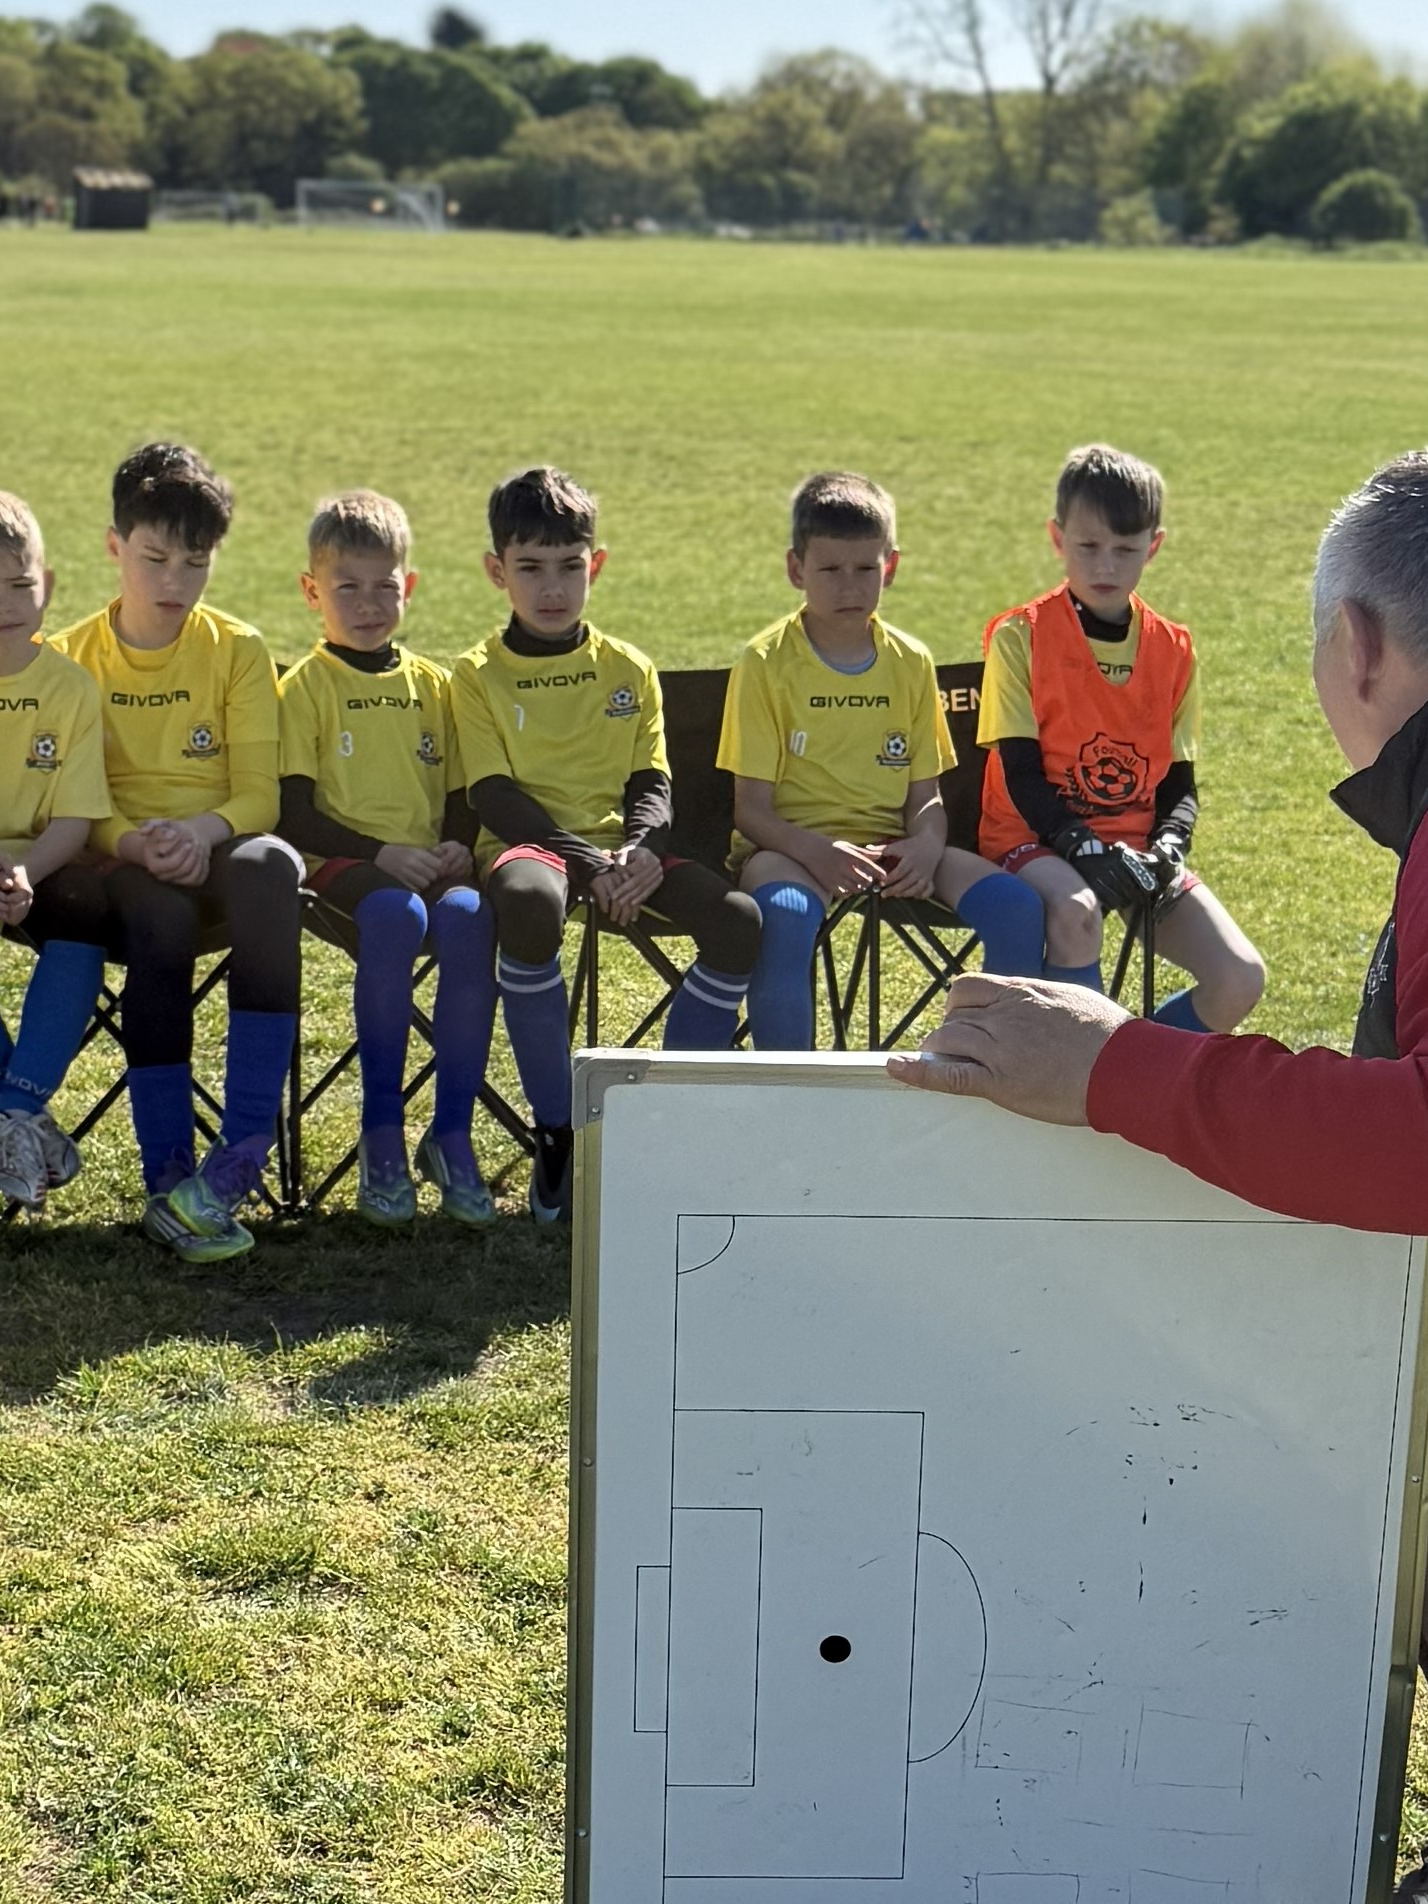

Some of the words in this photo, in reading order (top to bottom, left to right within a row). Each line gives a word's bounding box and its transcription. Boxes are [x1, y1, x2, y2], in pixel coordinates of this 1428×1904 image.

[516, 671, 597, 689] GIVOVA
[111, 690, 190, 707] GIVOVA
[347, 696, 423, 711] GIVOVA
[809, 696, 890, 708] GIVOVA
[340, 731, 353, 757] 3
